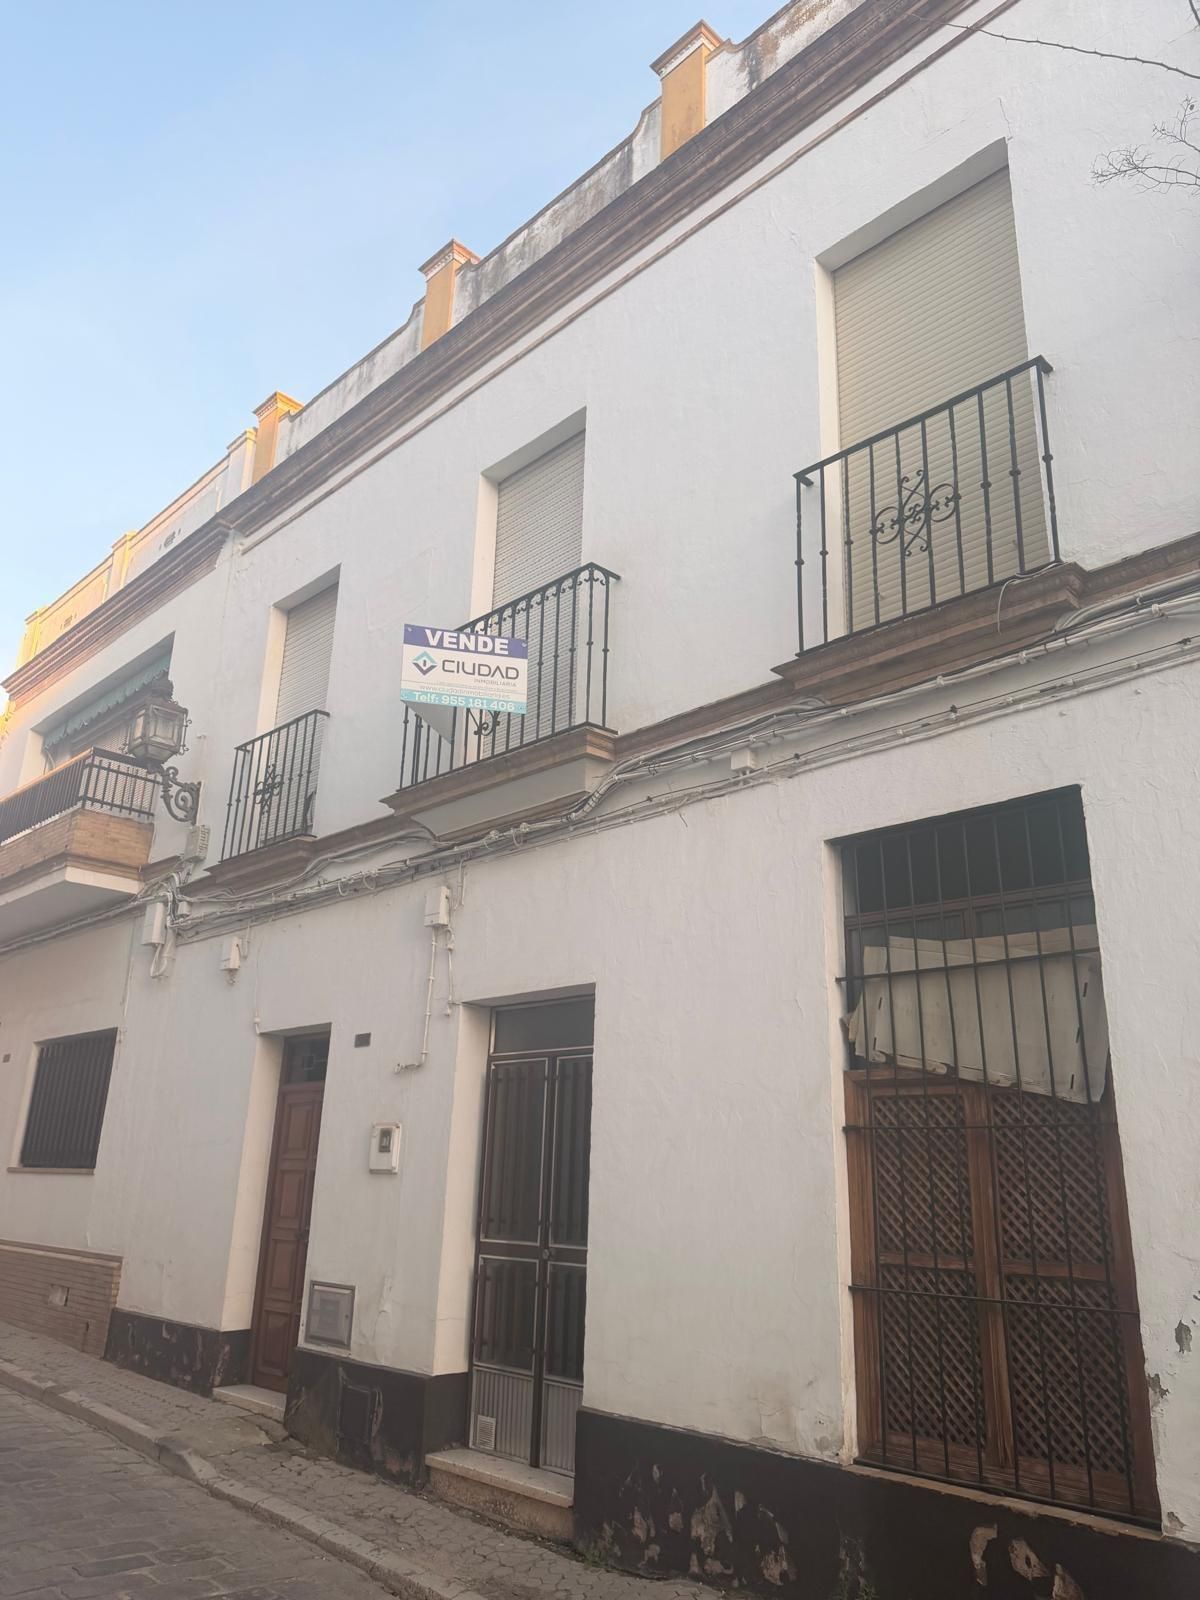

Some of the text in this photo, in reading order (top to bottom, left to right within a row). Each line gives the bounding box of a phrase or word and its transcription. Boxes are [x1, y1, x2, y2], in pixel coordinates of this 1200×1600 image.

[425, 629, 509, 655] VENDE
[442, 659, 520, 680] CIUDAD
[474, 678, 517, 687] INMOBILIARIA
[414, 692, 439, 703] Telf:
[441, 695, 466, 706] 955
[468, 698, 487, 708] 181
